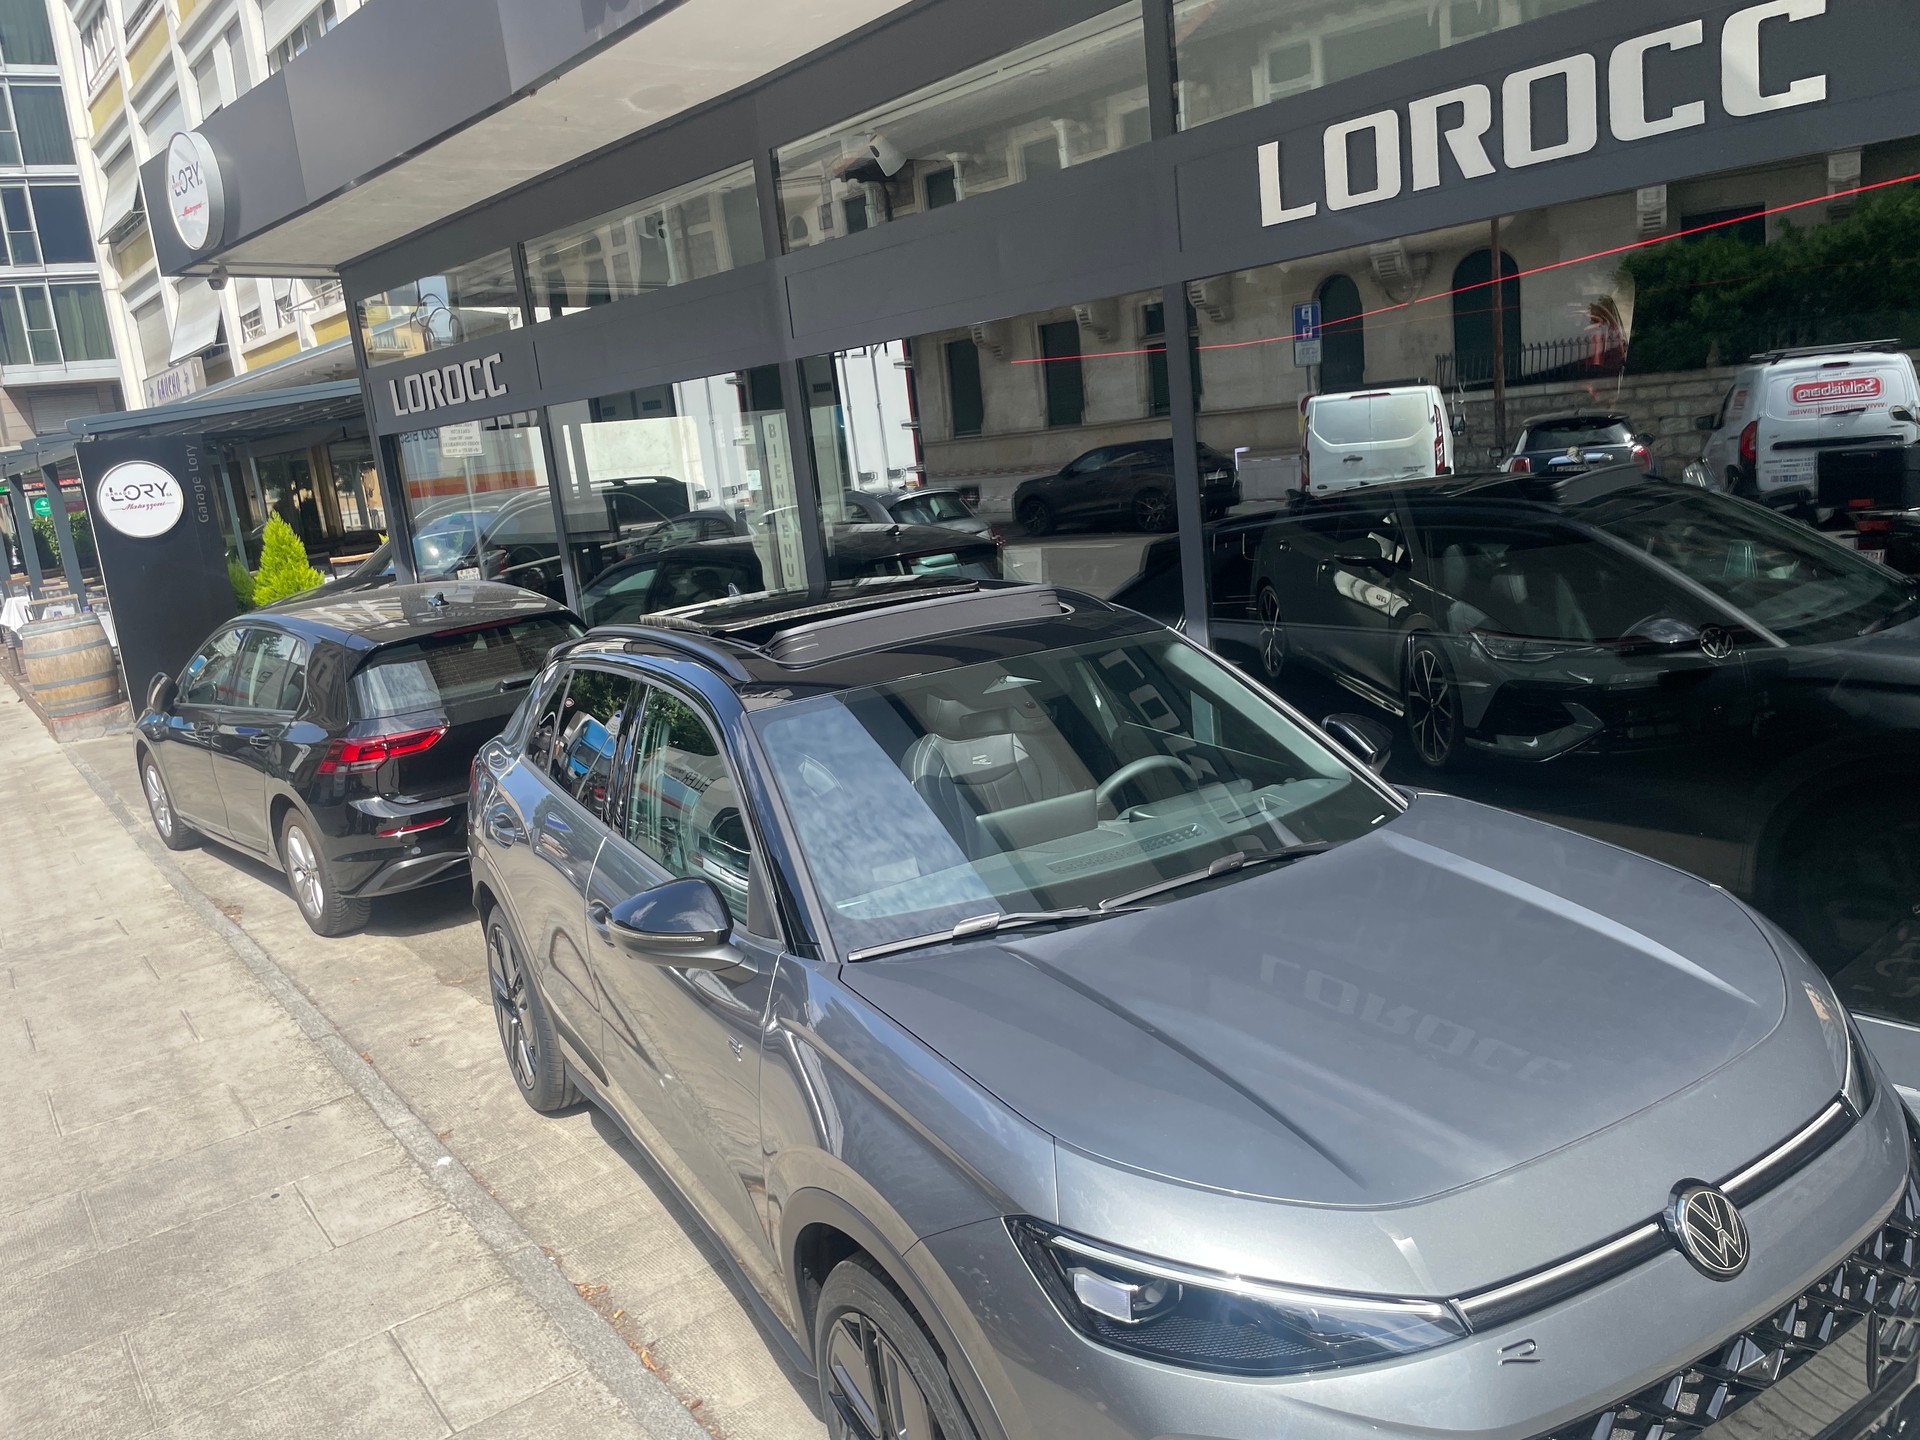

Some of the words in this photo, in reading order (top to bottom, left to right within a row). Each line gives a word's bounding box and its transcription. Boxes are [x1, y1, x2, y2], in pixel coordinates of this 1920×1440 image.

[1257, 0, 1828, 228] LOROCC
[171, 161, 200, 197] LORY
[389, 352, 508, 417] LOROCC
[185, 445, 199, 472] Lory
[109, 482, 168, 502] LORY
[192, 477, 209, 523] Garage
[767, 423, 797, 588] BIENVENU
